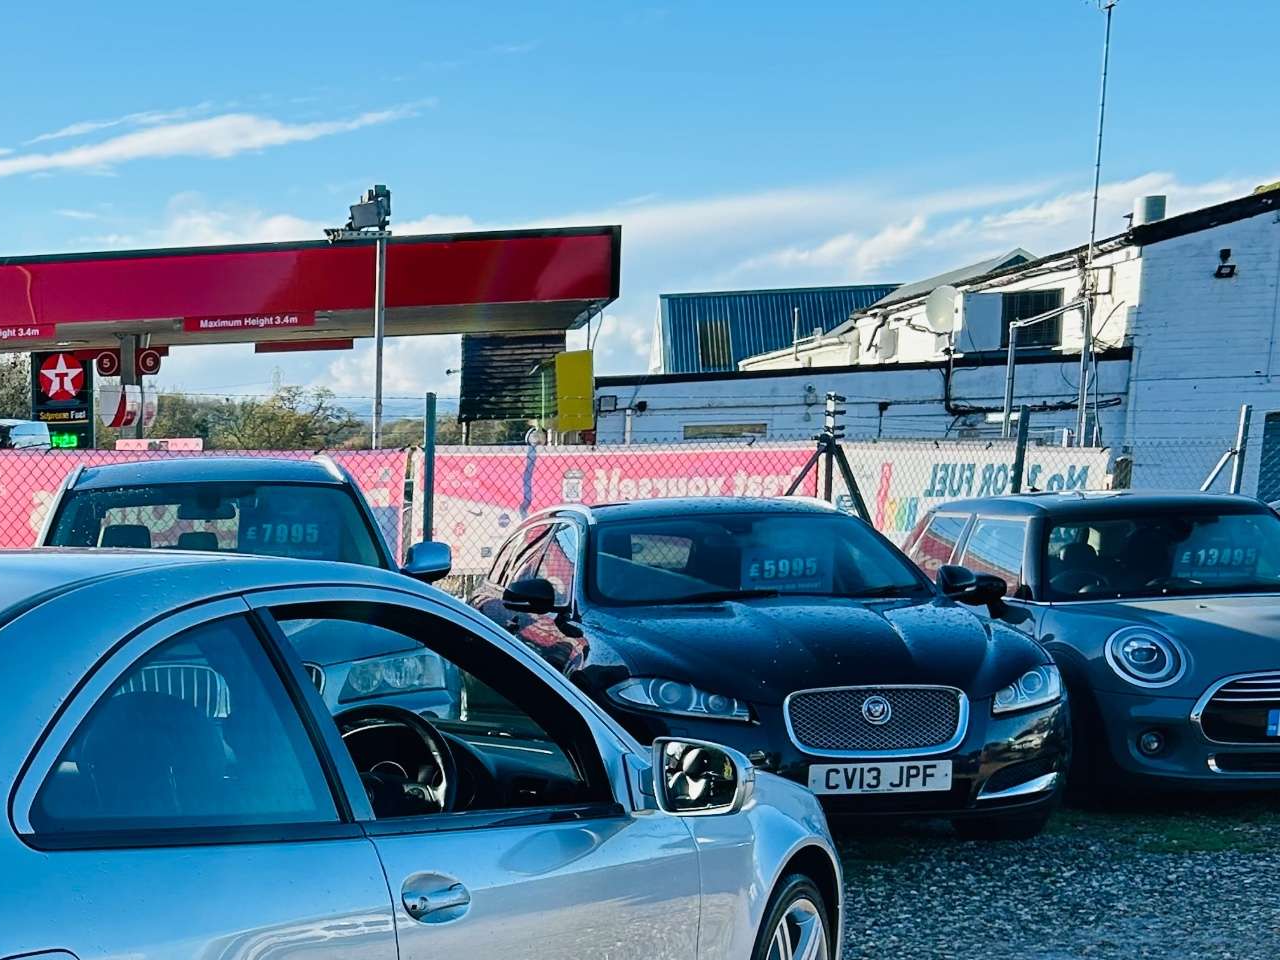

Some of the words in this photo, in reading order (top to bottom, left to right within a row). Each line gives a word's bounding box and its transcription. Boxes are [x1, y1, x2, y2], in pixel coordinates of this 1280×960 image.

[200, 319, 242, 329] Maximum
[244, 317, 274, 327] Height
[275, 315, 298, 325] 3.4m
[17, 327, 40, 336] 3.4m
[102, 359, 111, 368] 5
[146, 357, 154, 367] 6
[824, 766, 882, 790] CV13
[889, 764, 937, 788] JPF
